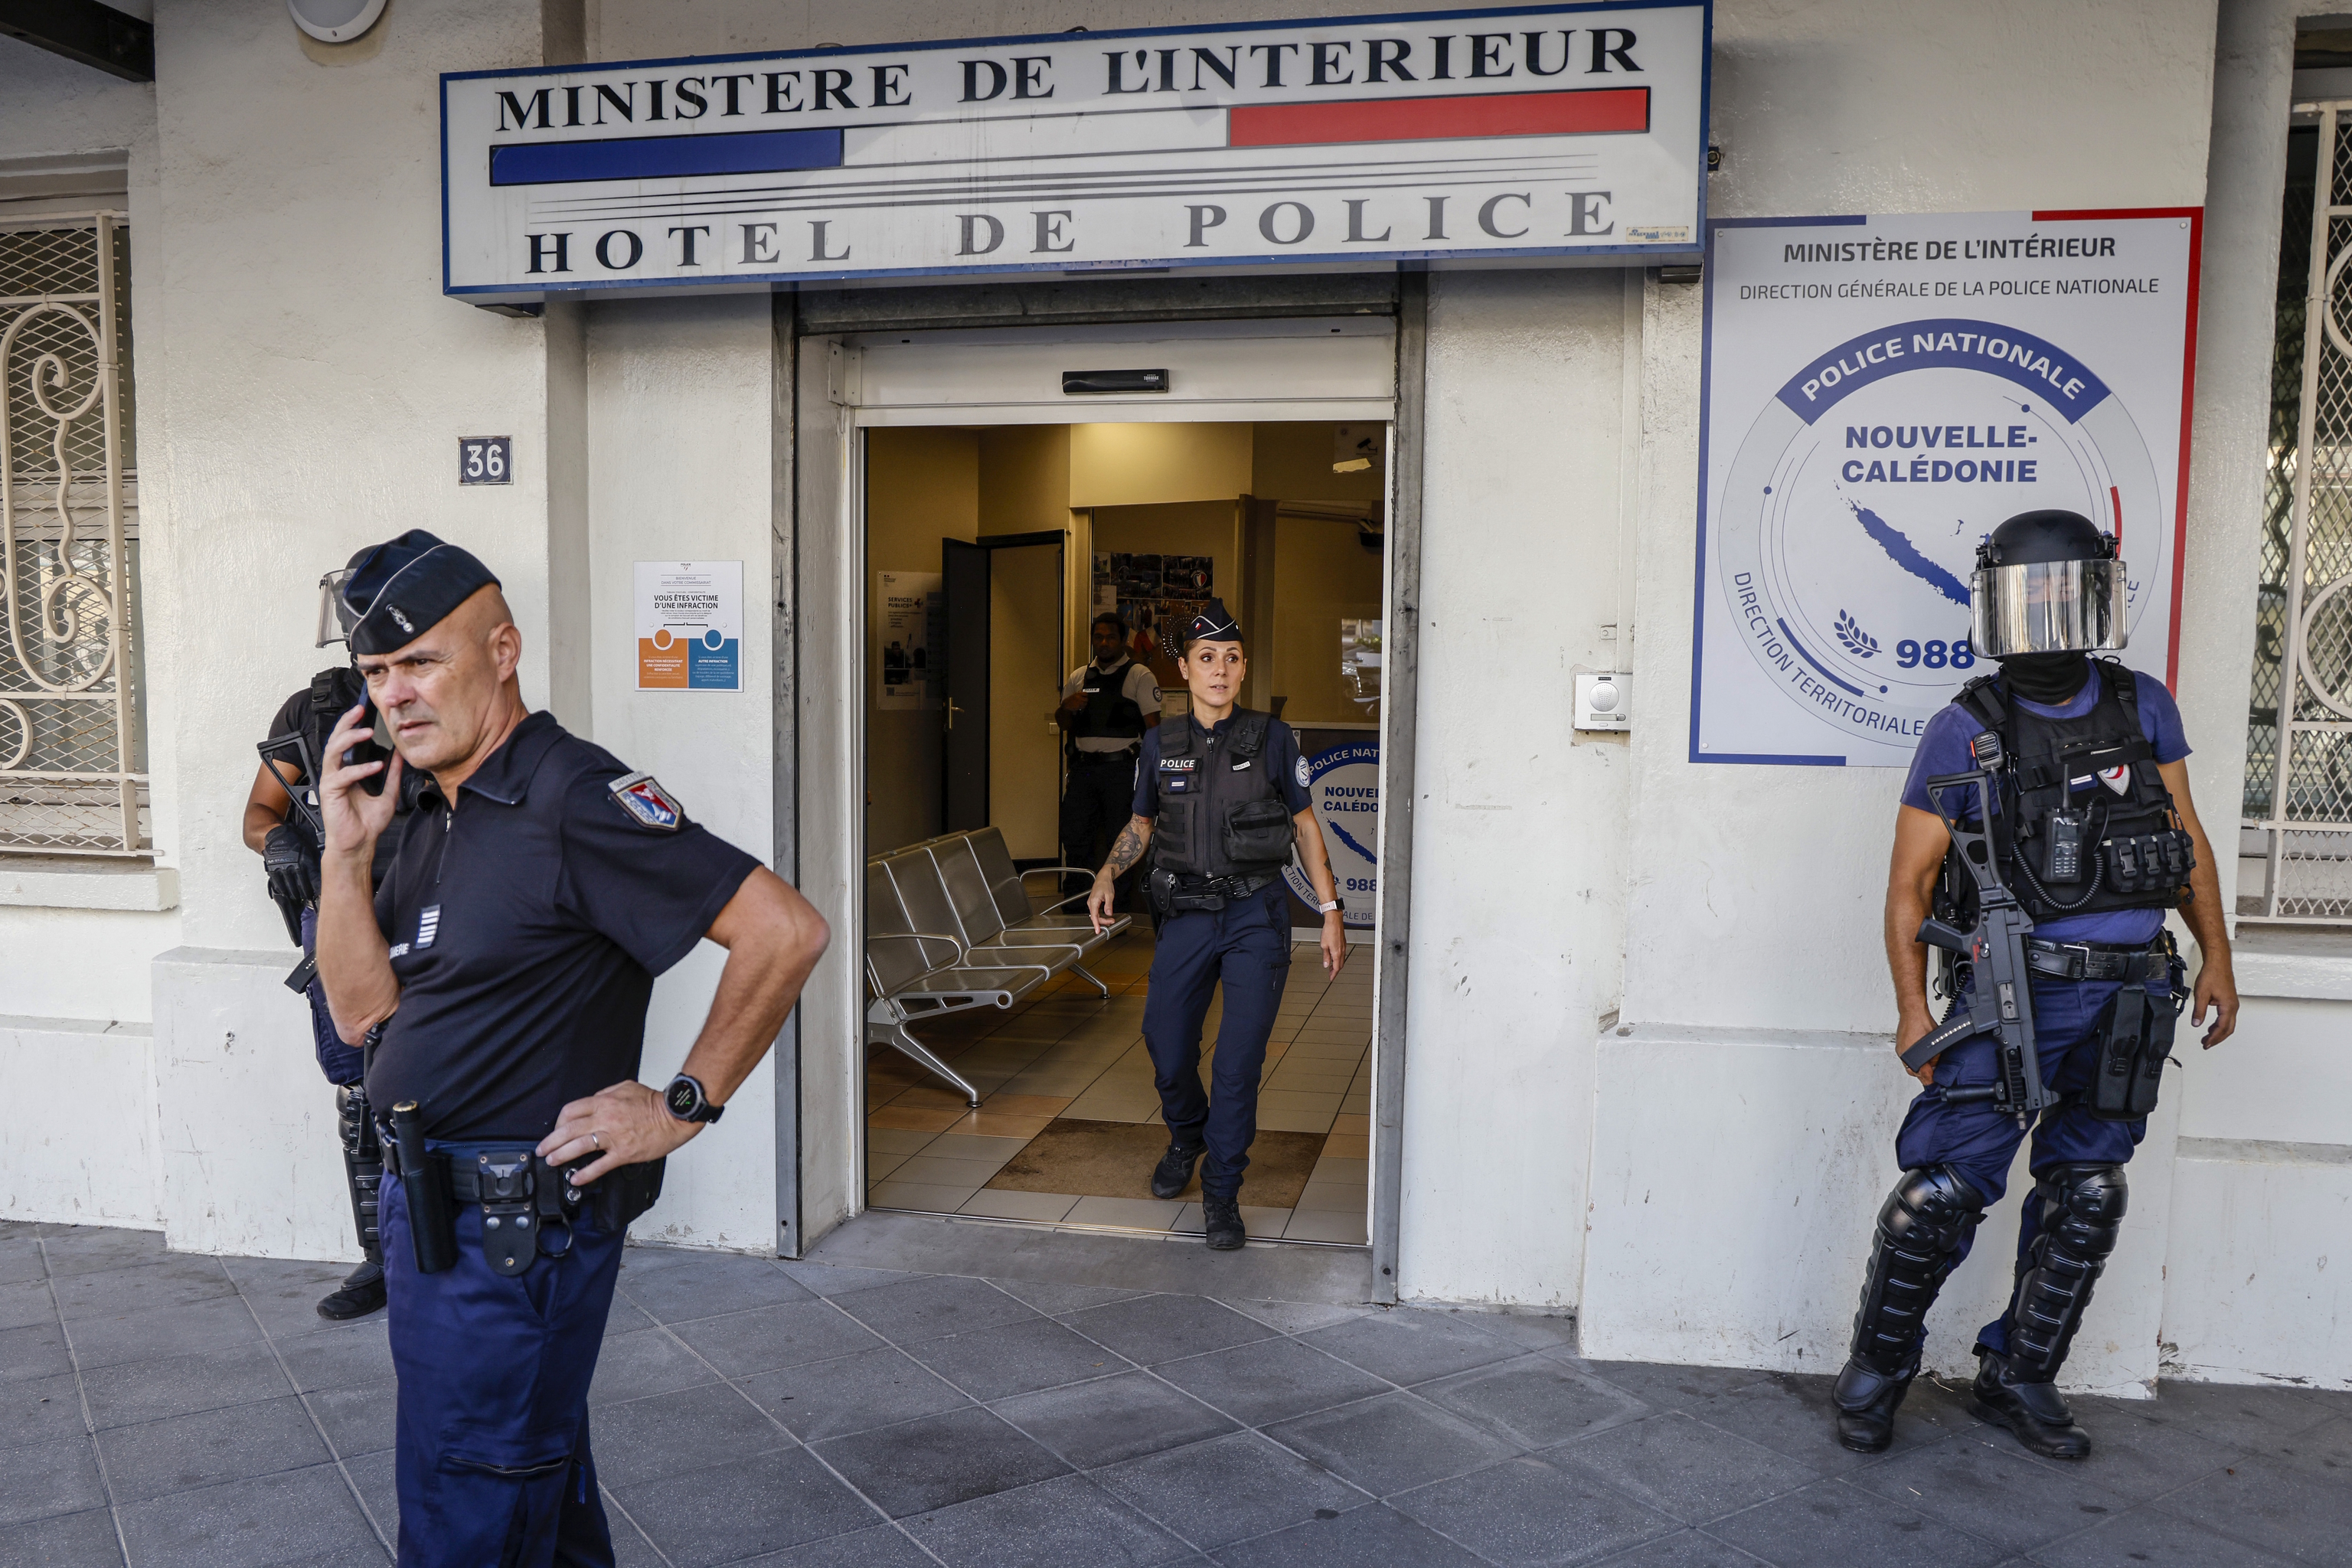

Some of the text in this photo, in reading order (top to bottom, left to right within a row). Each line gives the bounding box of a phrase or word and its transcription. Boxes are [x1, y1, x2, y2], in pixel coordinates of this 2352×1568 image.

[495, 28, 1645, 132] MINISTERE DE L'INTERIEUR
[524, 191, 1615, 275] HOTEL DE POLICE
[1784, 233, 2115, 263] MINISTÈRE DE L’INTÉRIEUR
[1740, 278, 2159, 299] DIRECTION GÉNÉRALE DE LA POLICE NATIONALE
[1801, 332, 2086, 402] POLICE NATIONALE
[1846, 426, 2037, 449] NOUVELLE-
[466, 444, 504, 477] 36
[1842, 453, 2037, 483] CALÉDONIE
[674, 593, 690, 602] ÊTES
[1734, 572, 1926, 736] DIRECTION TERRITORIALE
[1896, 639, 1975, 669] 988
[1160, 759, 1195, 769] POLICE
[1309, 750, 1350, 776] POLICE
[1324, 799, 1378, 812] CALÉDO
[1325, 787, 1378, 799] NOUVE
[1284, 864, 1305, 891] CTION
[1347, 877, 1377, 892] 988
